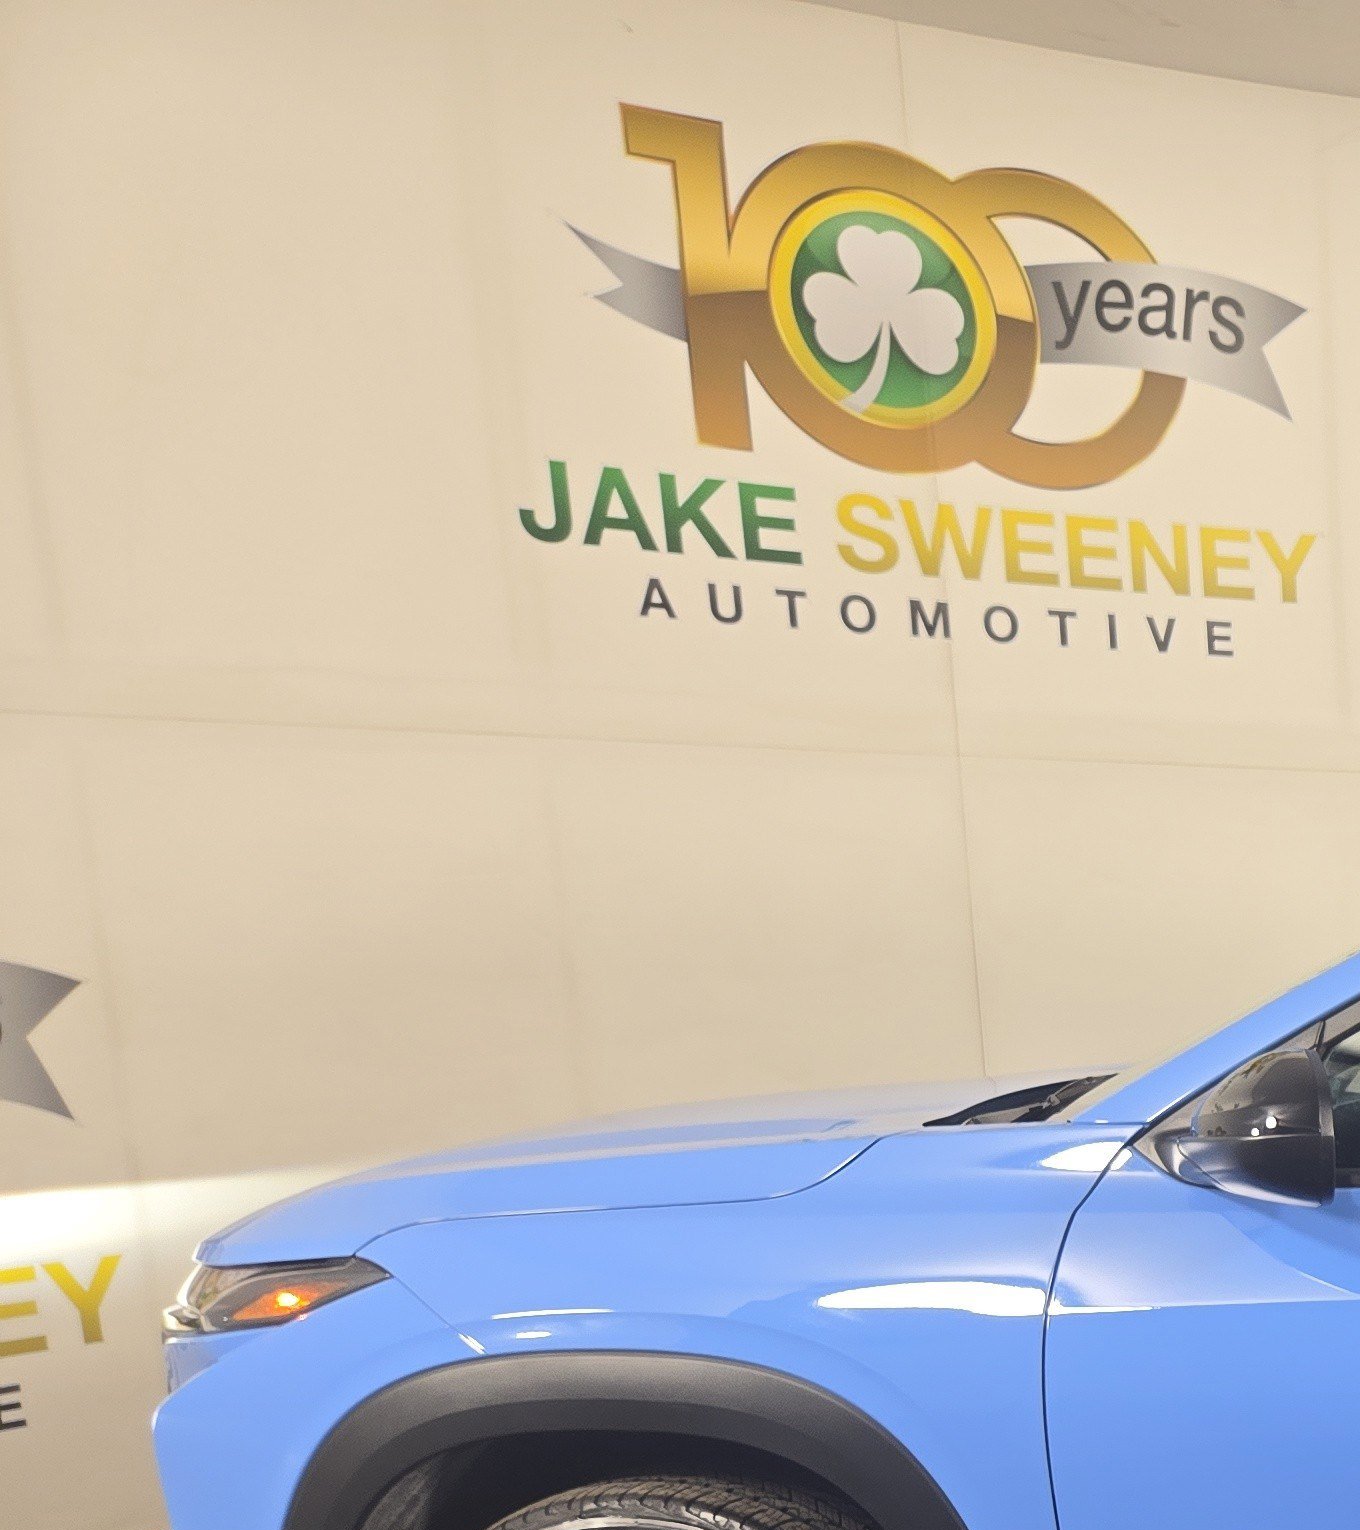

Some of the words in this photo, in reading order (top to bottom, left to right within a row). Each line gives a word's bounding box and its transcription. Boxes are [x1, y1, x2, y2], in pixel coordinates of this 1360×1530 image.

[1050, 274, 1248, 355] years
[517, 459, 804, 566] JAKE
[836, 492, 1318, 605] SWEENEY
[639, 576, 1236, 658] AUTOMOTIVE
[0, 1256, 122, 1359] EY
